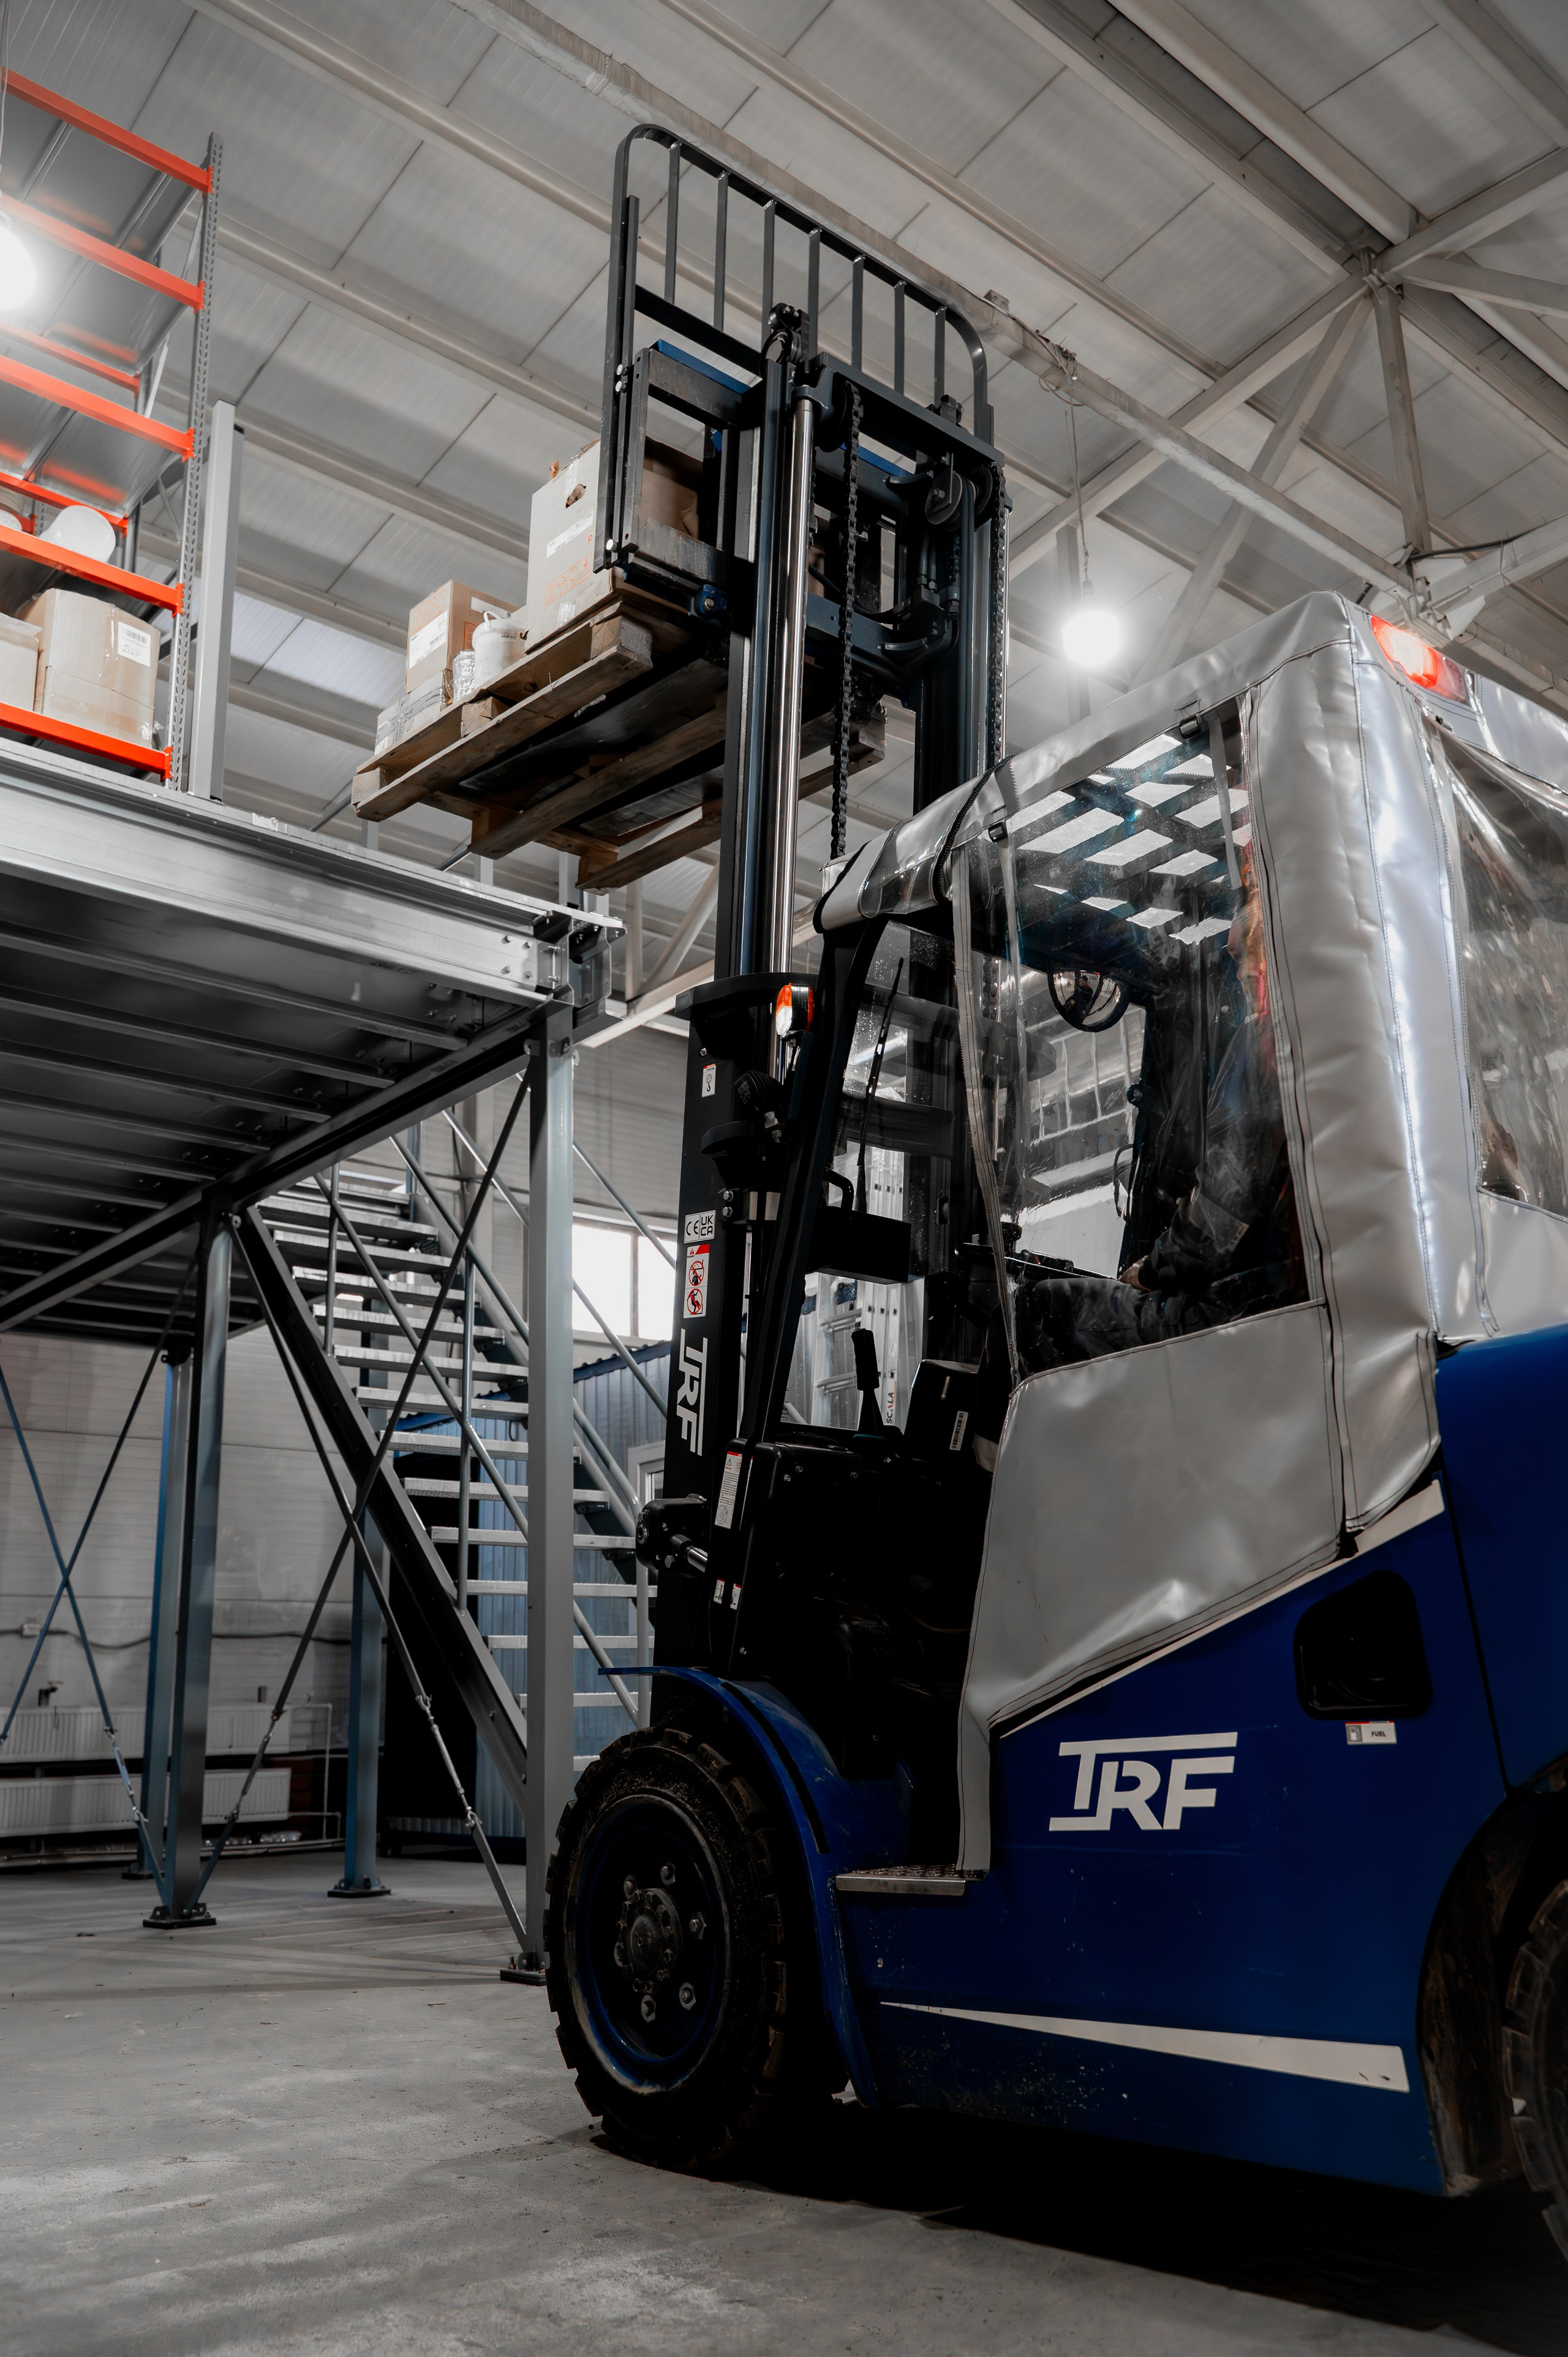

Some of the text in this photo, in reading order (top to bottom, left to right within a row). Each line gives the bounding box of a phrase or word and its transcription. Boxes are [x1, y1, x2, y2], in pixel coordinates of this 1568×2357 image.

[686, 1220, 699, 1236] CE
[701, 1215, 714, 1225] UK
[700, 1226, 713, 1236] CA
[676, 1328, 708, 1457] TRF
[1049, 1732, 1238, 1831] TRF
